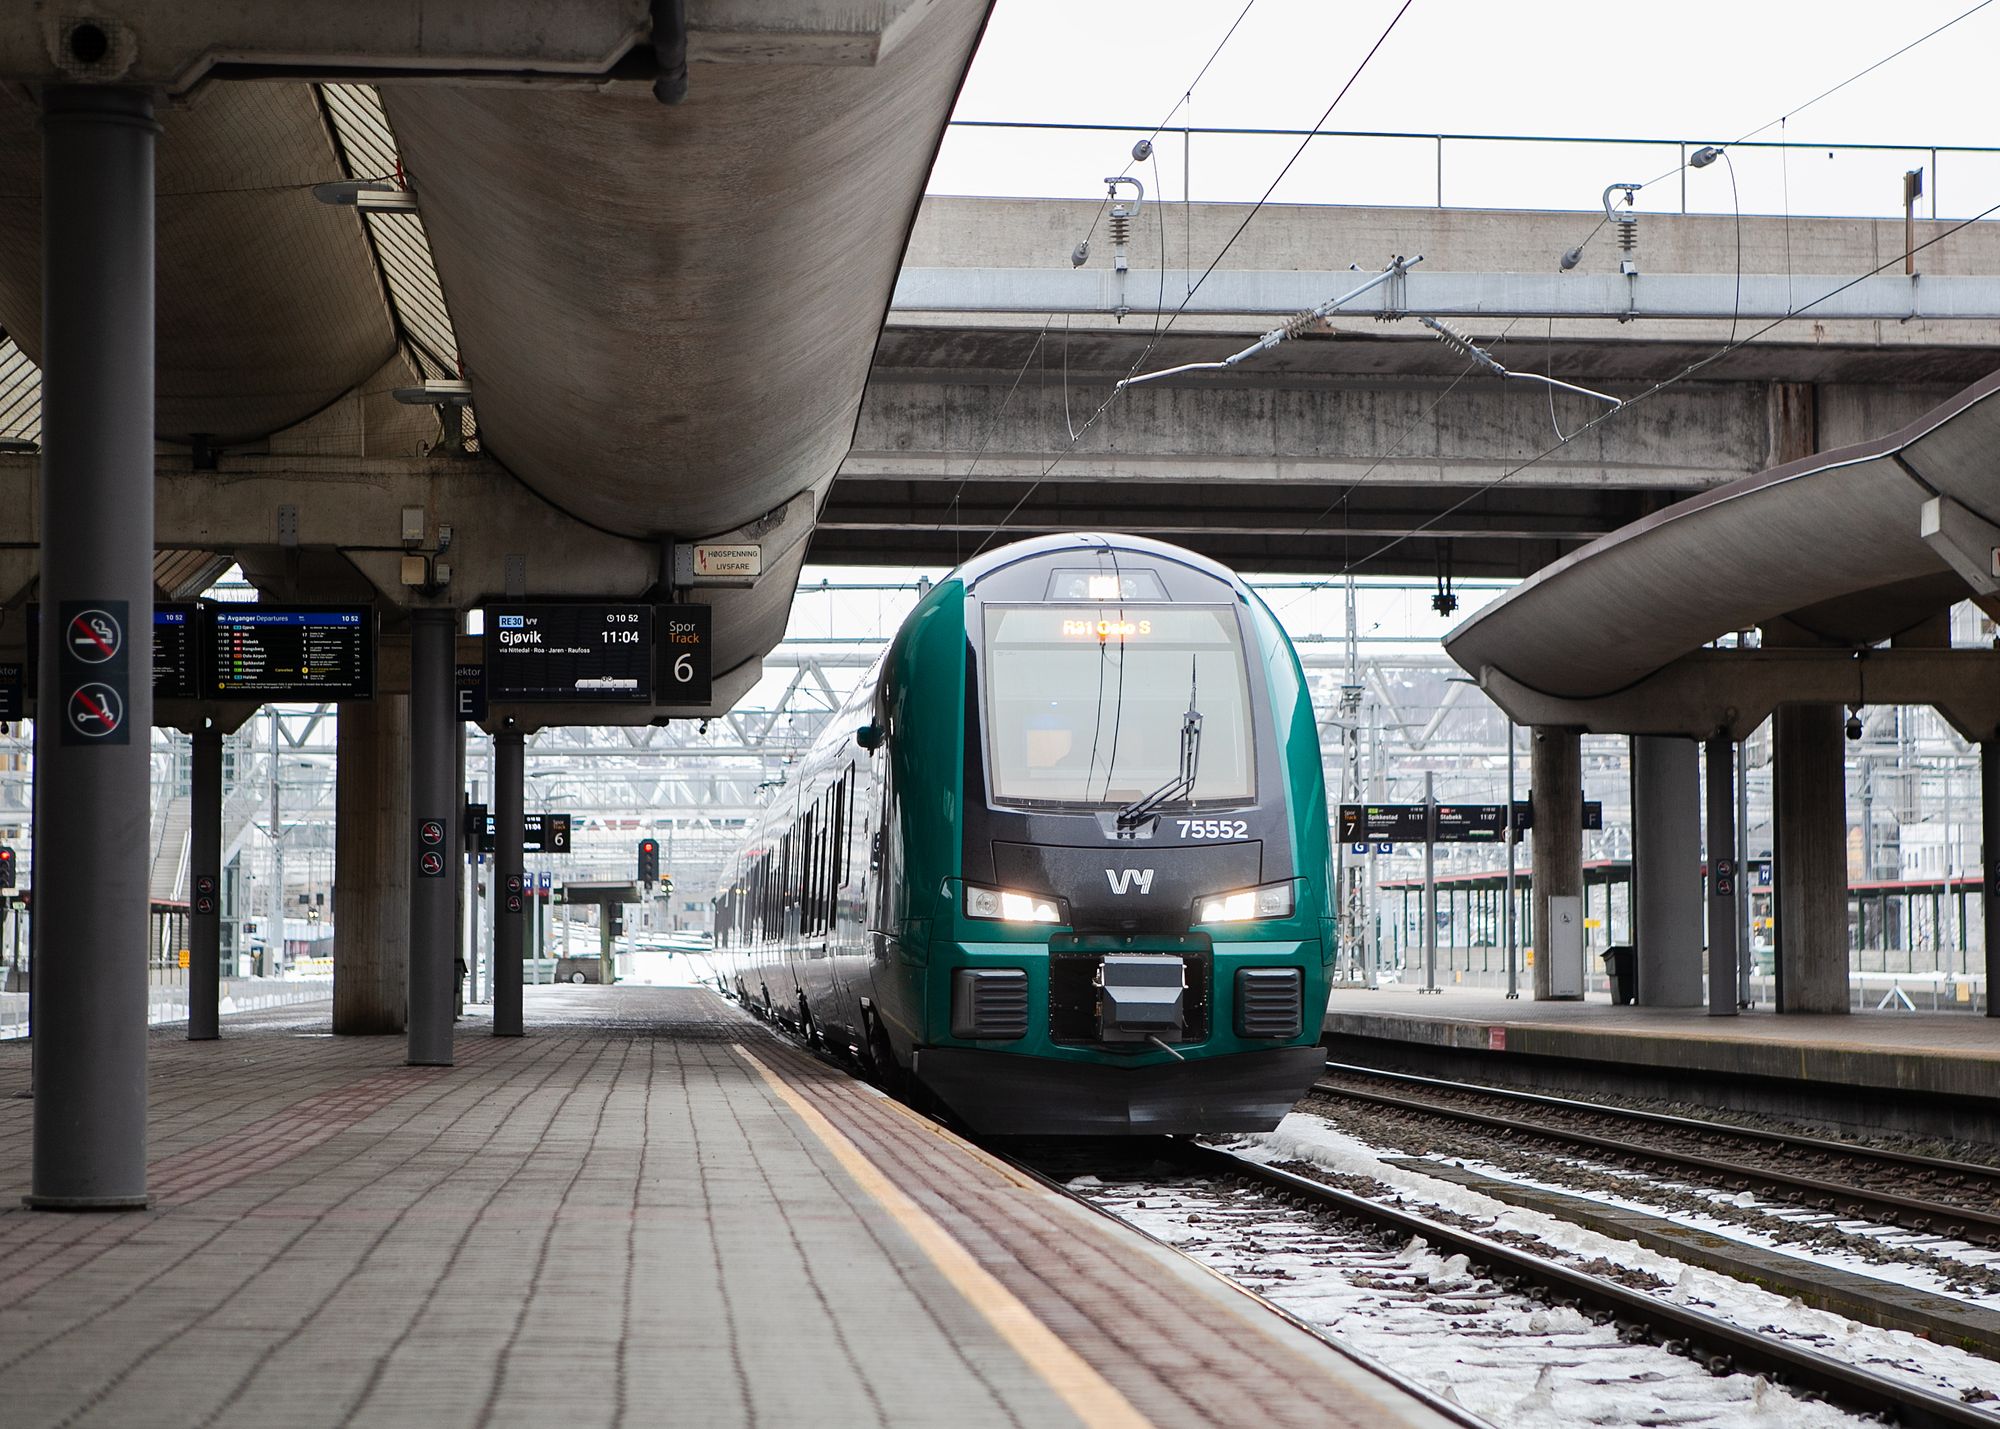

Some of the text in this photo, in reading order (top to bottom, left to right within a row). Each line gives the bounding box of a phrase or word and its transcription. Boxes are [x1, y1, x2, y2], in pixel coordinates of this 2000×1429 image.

[708, 550, 758, 559] HØGSPENNING
[227, 615, 255, 623] Avganger
[256, 614, 288, 623] Departures
[669, 620, 696, 634] Spor
[1138, 620, 1152, 634] S
[499, 631, 542, 646] Gjøvik
[601, 631, 639, 643] 11:04
[669, 633, 700, 644] Track
[456, 667, 481, 677] ektor
[674, 653, 694, 683] 6
[459, 689, 473, 713] E
[1517, 813, 1525, 826] F
[1588, 813, 1597, 826] F
[1176, 820, 1248, 839] 75552
[1346, 822, 1355, 836] 7
[554, 832, 564, 846] 6
[1354, 842, 1364, 852] G
[1380, 842, 1390, 852] G
[542, 878, 549, 888] H
